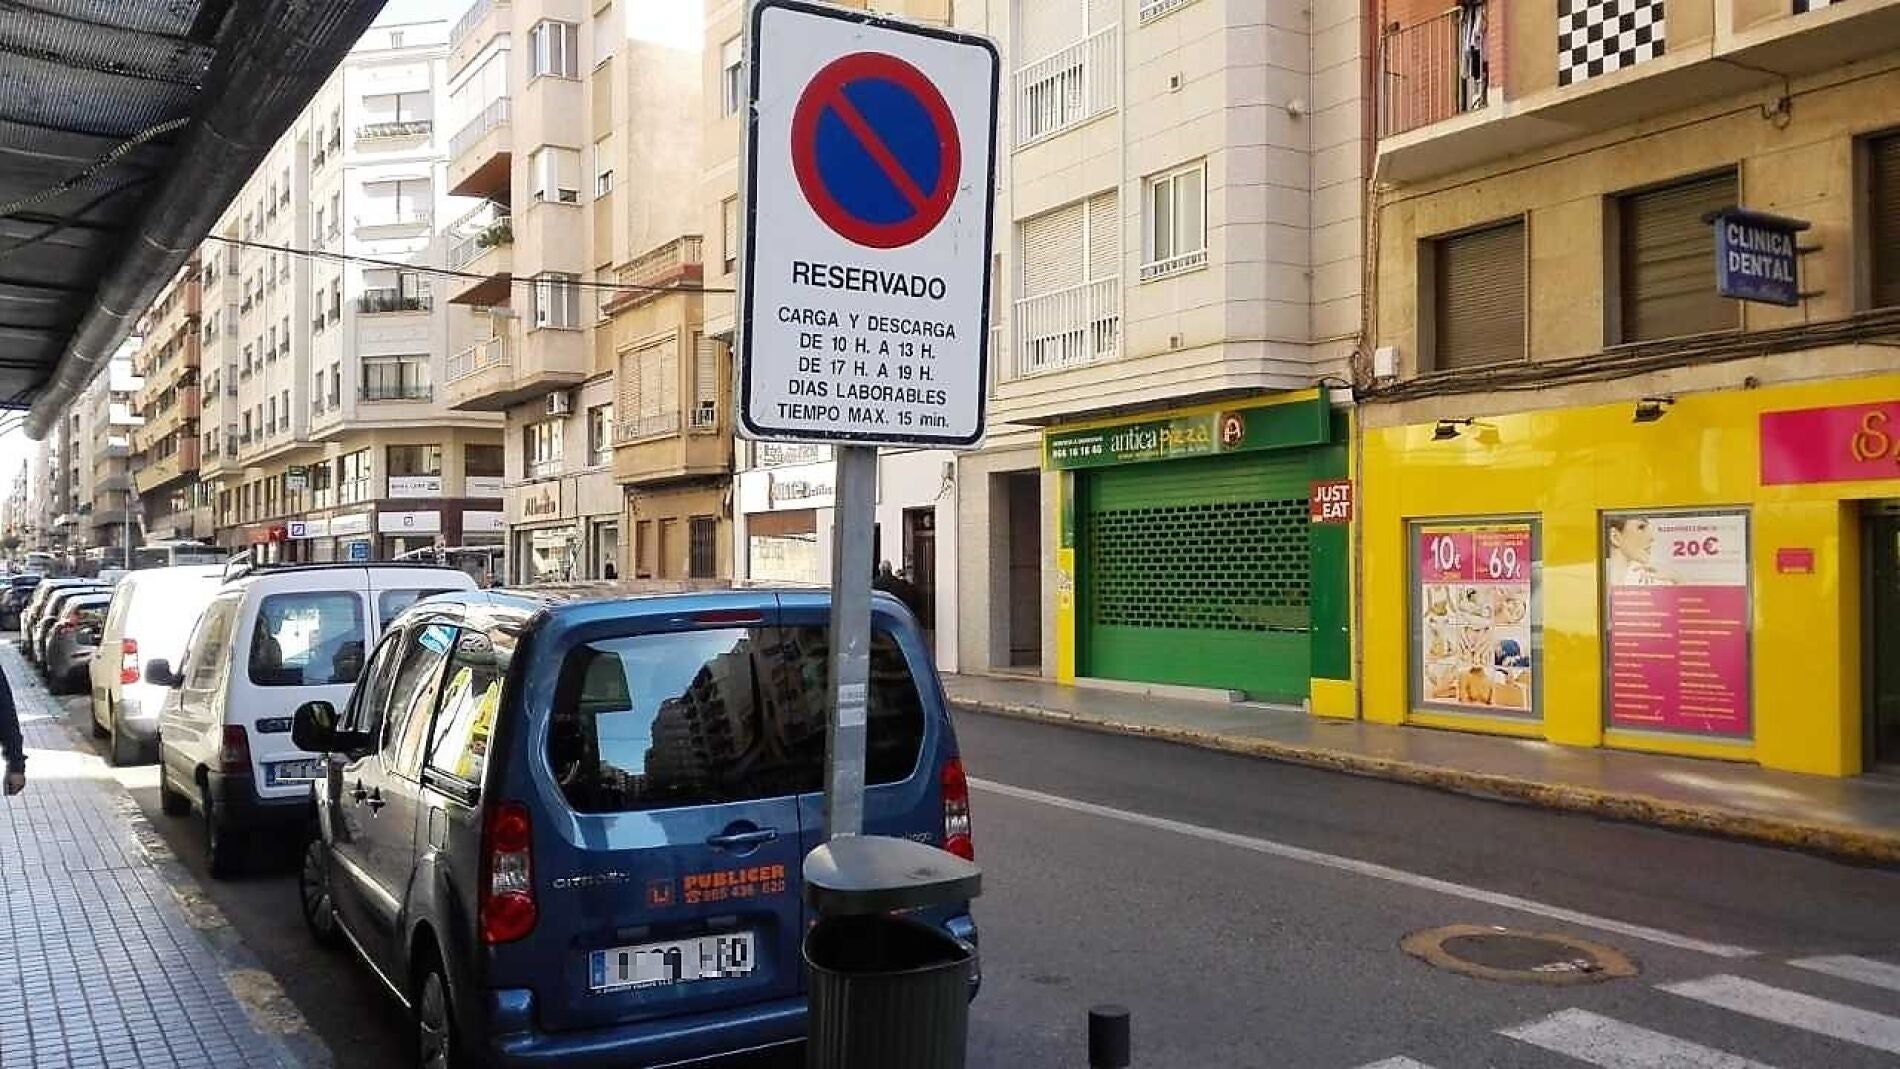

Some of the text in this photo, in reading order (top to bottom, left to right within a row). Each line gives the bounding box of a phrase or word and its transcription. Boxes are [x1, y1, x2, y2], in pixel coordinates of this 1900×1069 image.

[1727, 223, 1793, 256] CLINICA
[792, 261, 947, 300] RESERVADO
[1728, 253, 1793, 282] DENTAL
[778, 306, 956, 339] CARGA Y DESCARGA
[800, 333, 936, 359] DE 10 H. A 13 H.
[799, 356, 934, 381] DE 17 H. A 19 H.
[789, 379, 947, 405] DIAS LABORABLES
[777, 403, 950, 428] TIEMPO MAX. 15 min.
[1314, 485, 1350, 502] JUST
[1323, 501, 1350, 518] EAT
[683, 864, 785, 890] PUBLICER
